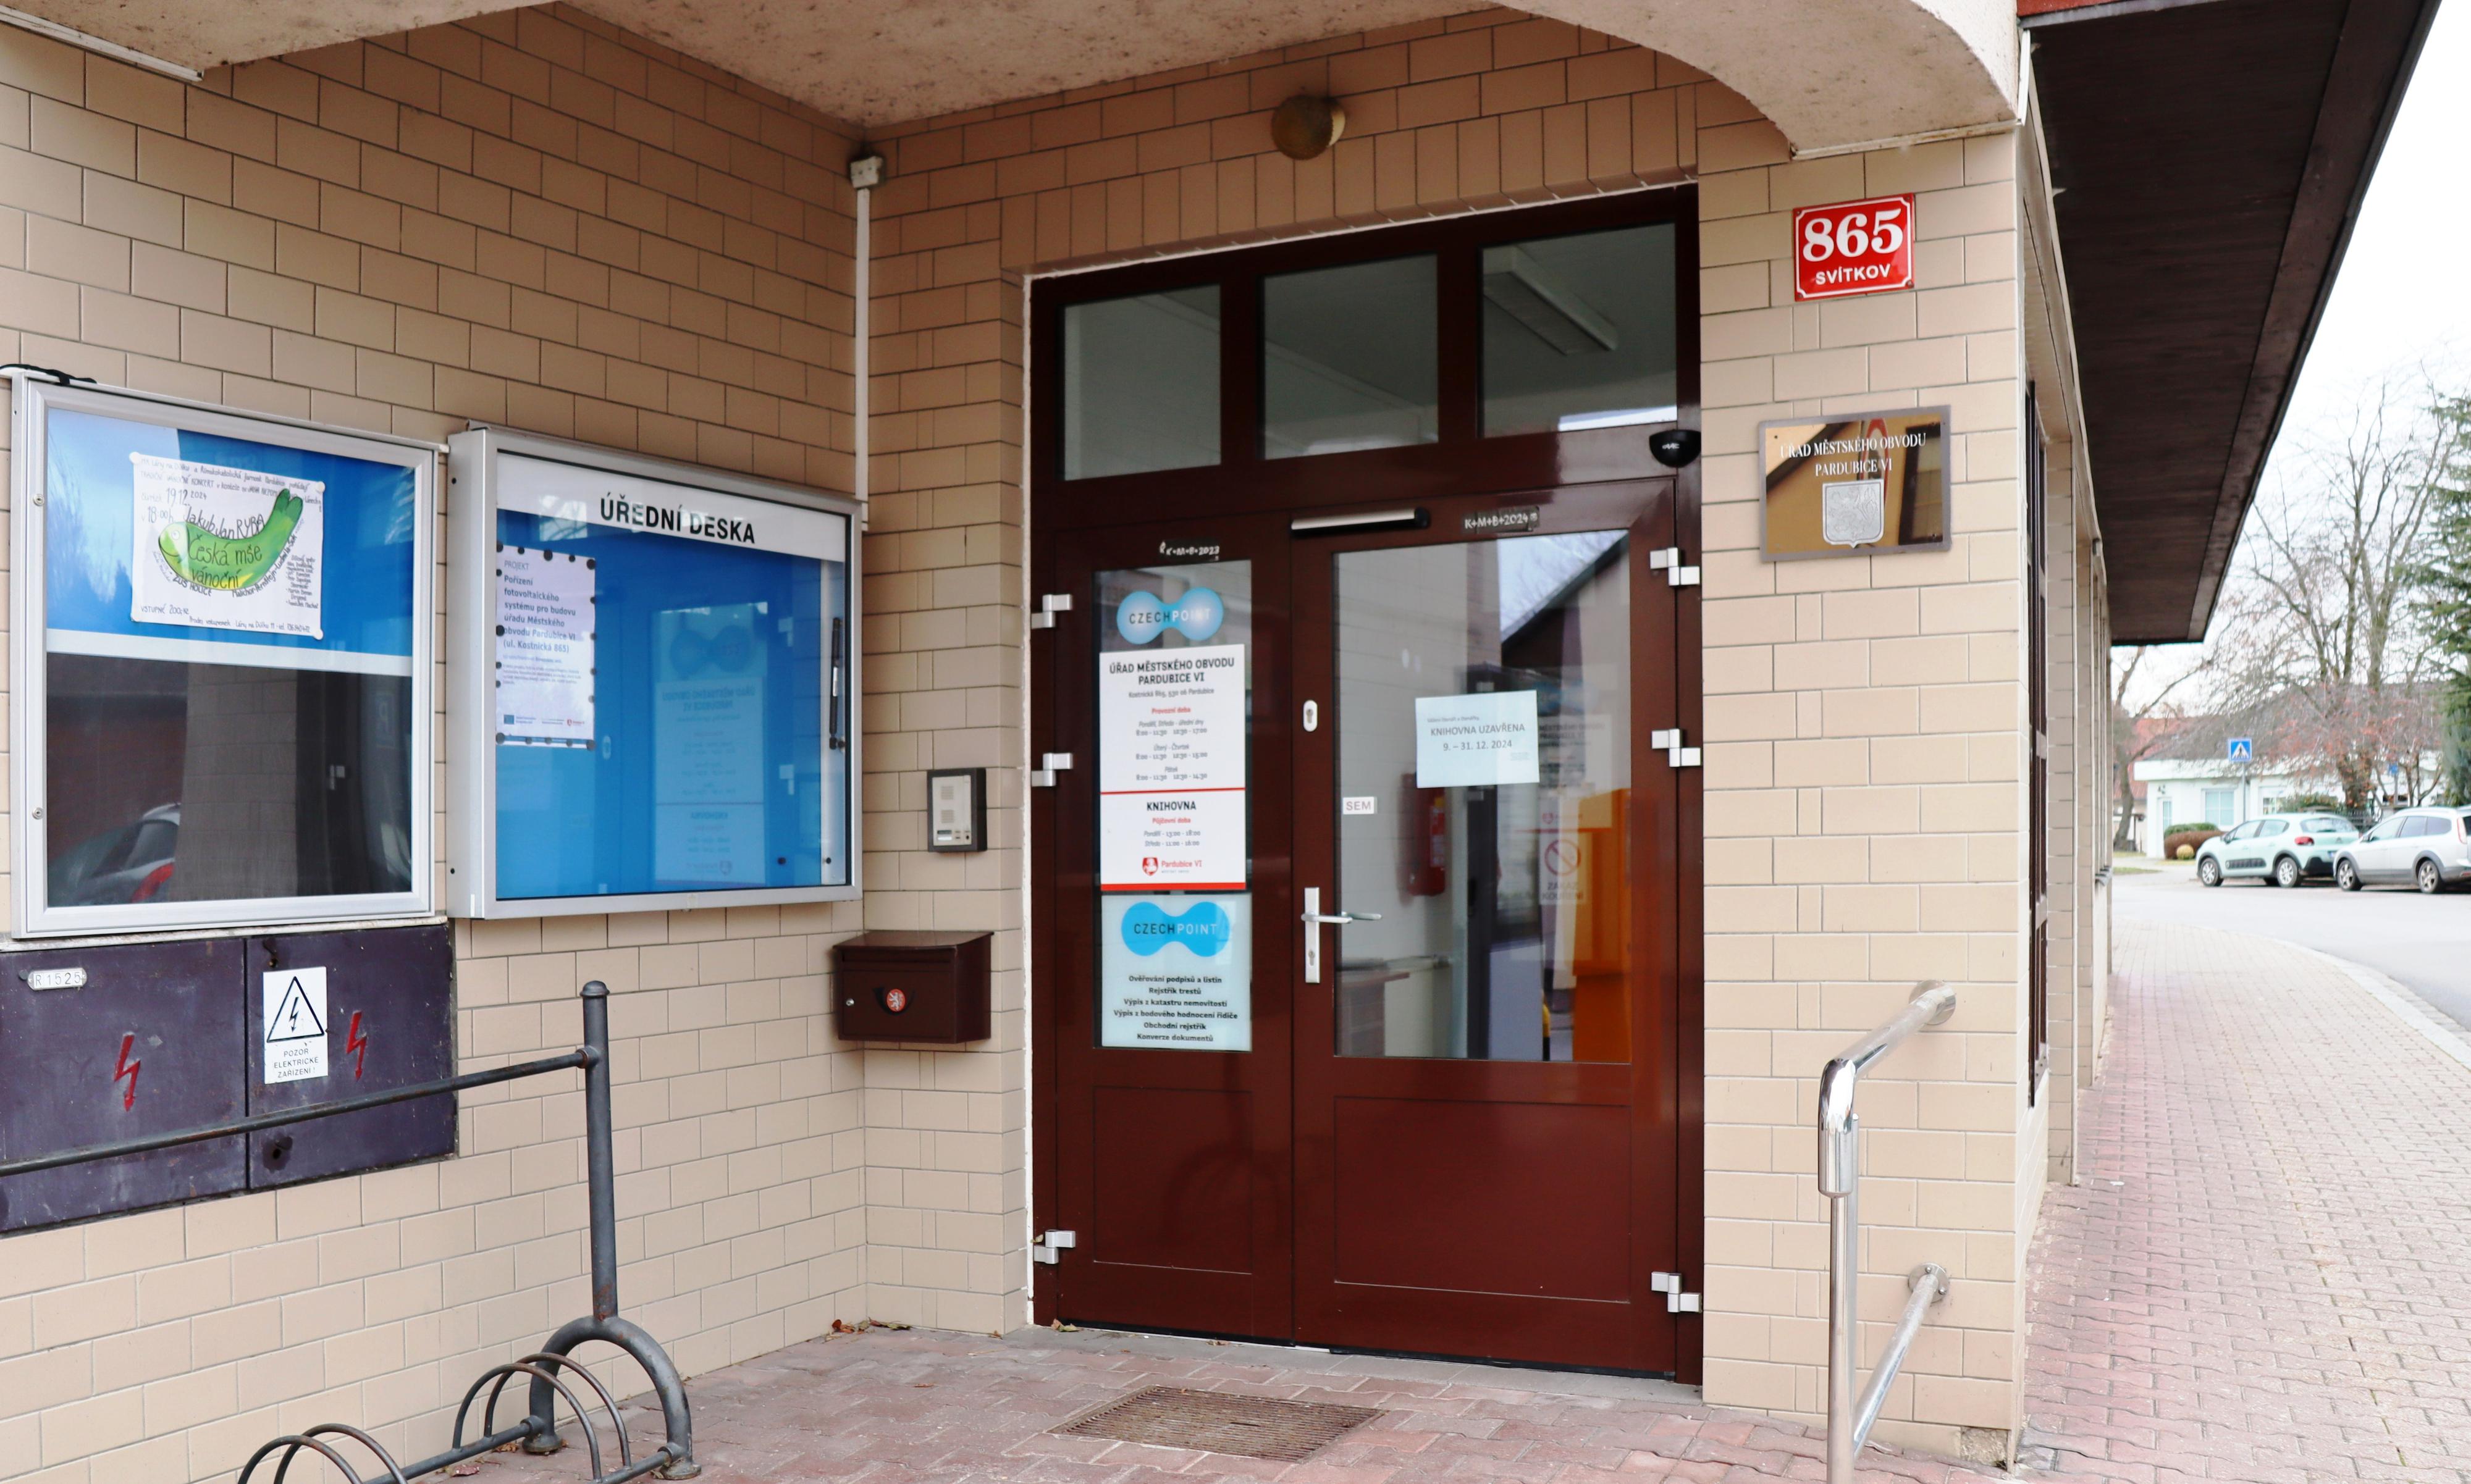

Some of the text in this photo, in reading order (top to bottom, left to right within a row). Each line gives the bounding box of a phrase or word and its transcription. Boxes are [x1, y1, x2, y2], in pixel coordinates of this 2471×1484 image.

[1803, 208, 1903, 262] 865
[1815, 264, 1891, 285] SVÍTKOV
[1814, 437, 1877, 456] MĚSTSKÉHO
[1880, 432, 1926, 450] OBVODU
[1815, 458, 1892, 476] PARDUBICE VI
[191, 491, 207, 500] 2024
[183, 506, 216, 533] Jakub
[216, 518, 235, 539] Jan
[236, 514, 265, 539] RYBA
[600, 492, 756, 543] ÚŘEDNÍ DESKA
[189, 534, 263, 566] Česká mše
[504, 560, 529, 571] PROJEKT
[192, 566, 242, 589] vánoční
[504, 575, 533, 586] Pořízení
[504, 587, 560, 602] fotovoltaického
[141, 603, 166, 614] VSTUPNÉ
[504, 601, 576, 616] systému pro budovu
[504, 614, 565, 627] úřadu Městského
[504, 626, 576, 641] obvodu Pardubice VI
[503, 639, 569, 654] (ul. Kostnická 865)
[1109, 657, 1235, 674] ÚŘAD MĚSTSKÉHO OBVODU
[1139, 672, 1205, 685] PARDUBICE VI
[1189, 687, 1214, 695] Pardubice
[1431, 723, 1525, 736] KNIHOVNA UZAVŘENA
[1443, 743, 1450, 751] 9.
[1461, 742, 1473, 750] 31.
[1476, 742, 1489, 750] 12.
[1491, 740, 1512, 749] 2024
[1147, 801, 1197, 811] KNIHOVNA
[1346, 801, 1371, 811] SEM
[1166, 976, 1195, 984] podpisů
[1148, 987, 1177, 996] Rejstřík
[1124, 998, 1143, 1006] Výpis
[1113, 1010, 1133, 1018] Výpis
[1140, 1010, 1175, 1018] bodového
[1179, 1022, 1206, 1031] rejstřík
[284, 1049, 309, 1057] POZOR
